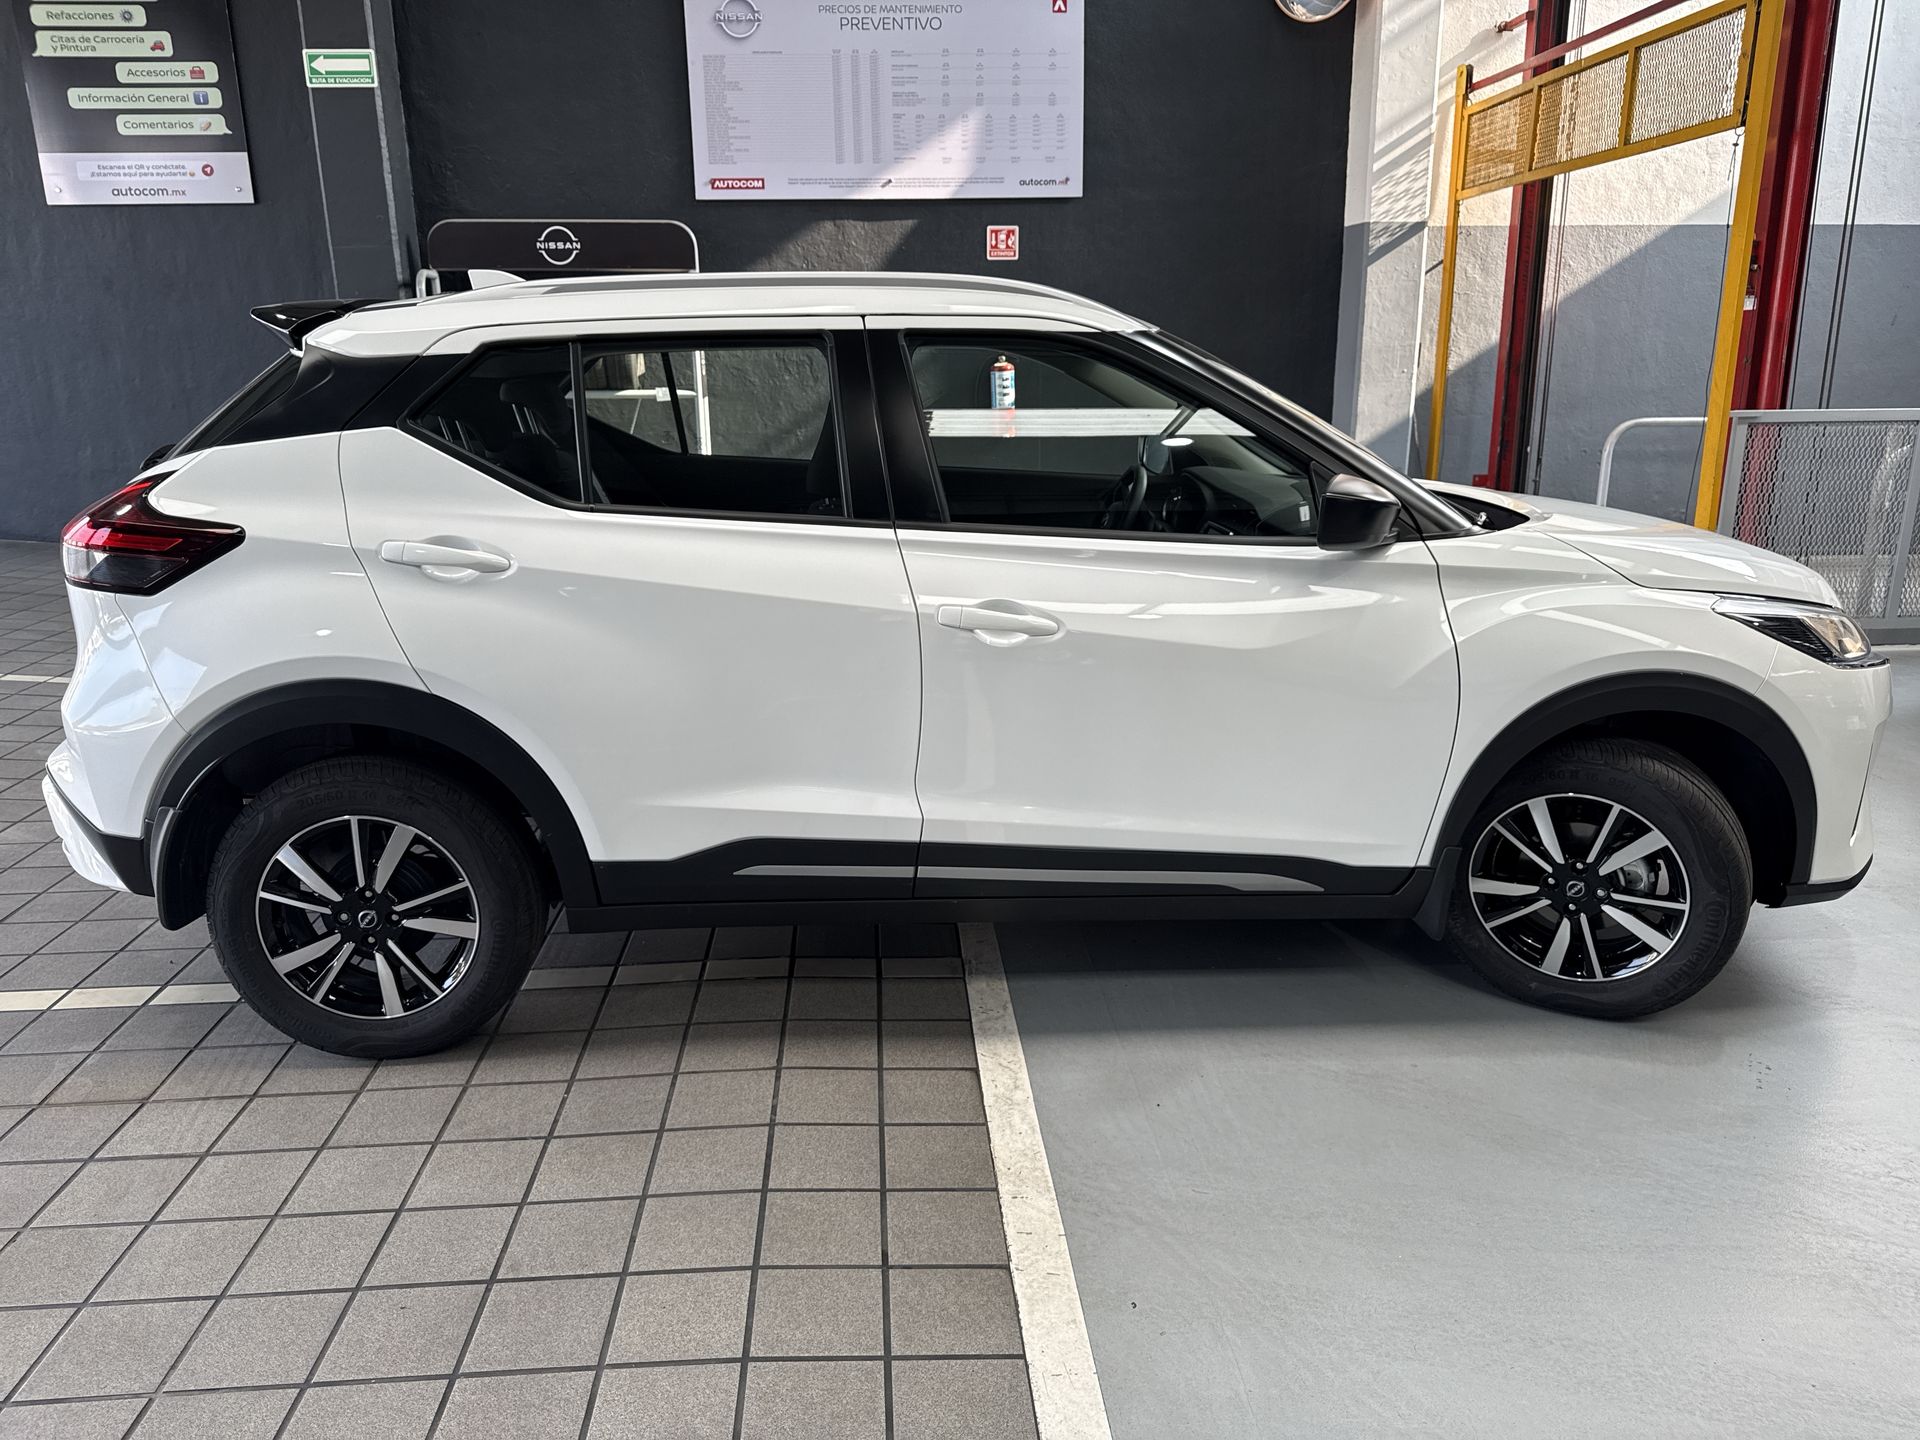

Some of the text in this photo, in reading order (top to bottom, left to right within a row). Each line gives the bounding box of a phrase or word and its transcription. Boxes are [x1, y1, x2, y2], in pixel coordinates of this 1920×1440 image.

[818, 4, 963, 14] PRECIOS DE MANTENIMIENTO
[45, 10, 114, 21] Refacciones
[715, 12, 763, 22] NISSAN
[839, 16, 943, 31] PREVENTIVO
[50, 35, 76, 44] Citas
[78, 35, 92, 44] de
[51, 43, 97, 53] y Pintura
[126, 67, 186, 77] Accesorios
[77, 93, 190, 103] Información General
[123, 120, 194, 129] Comentarios
[713, 179, 763, 189] AUTOCOM
[536, 241, 581, 250] NISSAN
